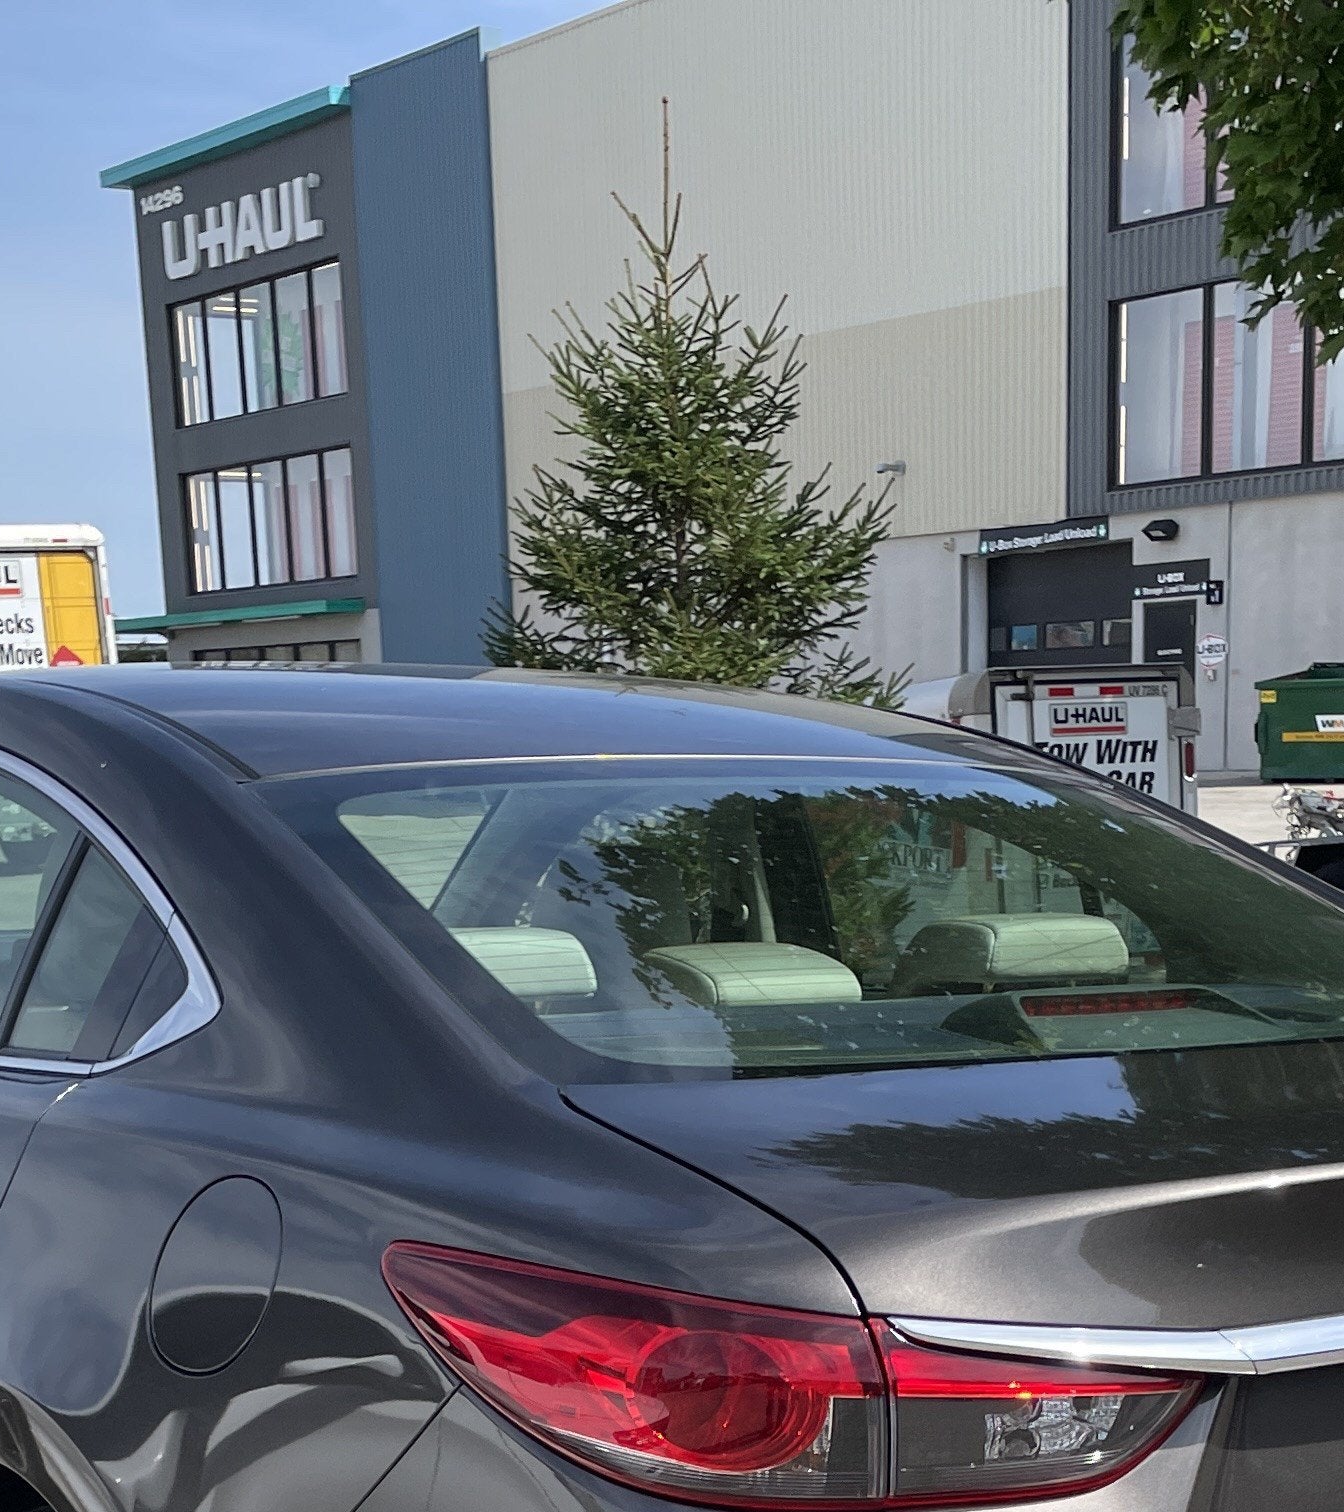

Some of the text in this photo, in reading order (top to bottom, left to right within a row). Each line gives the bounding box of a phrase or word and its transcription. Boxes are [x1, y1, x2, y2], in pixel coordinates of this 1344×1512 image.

[161, 175, 326, 281] U-HAUL
[0, 641, 44, 667] Move
[1053, 706, 1124, 724] U-HAUL
[1096, 739, 1158, 765] WITH
